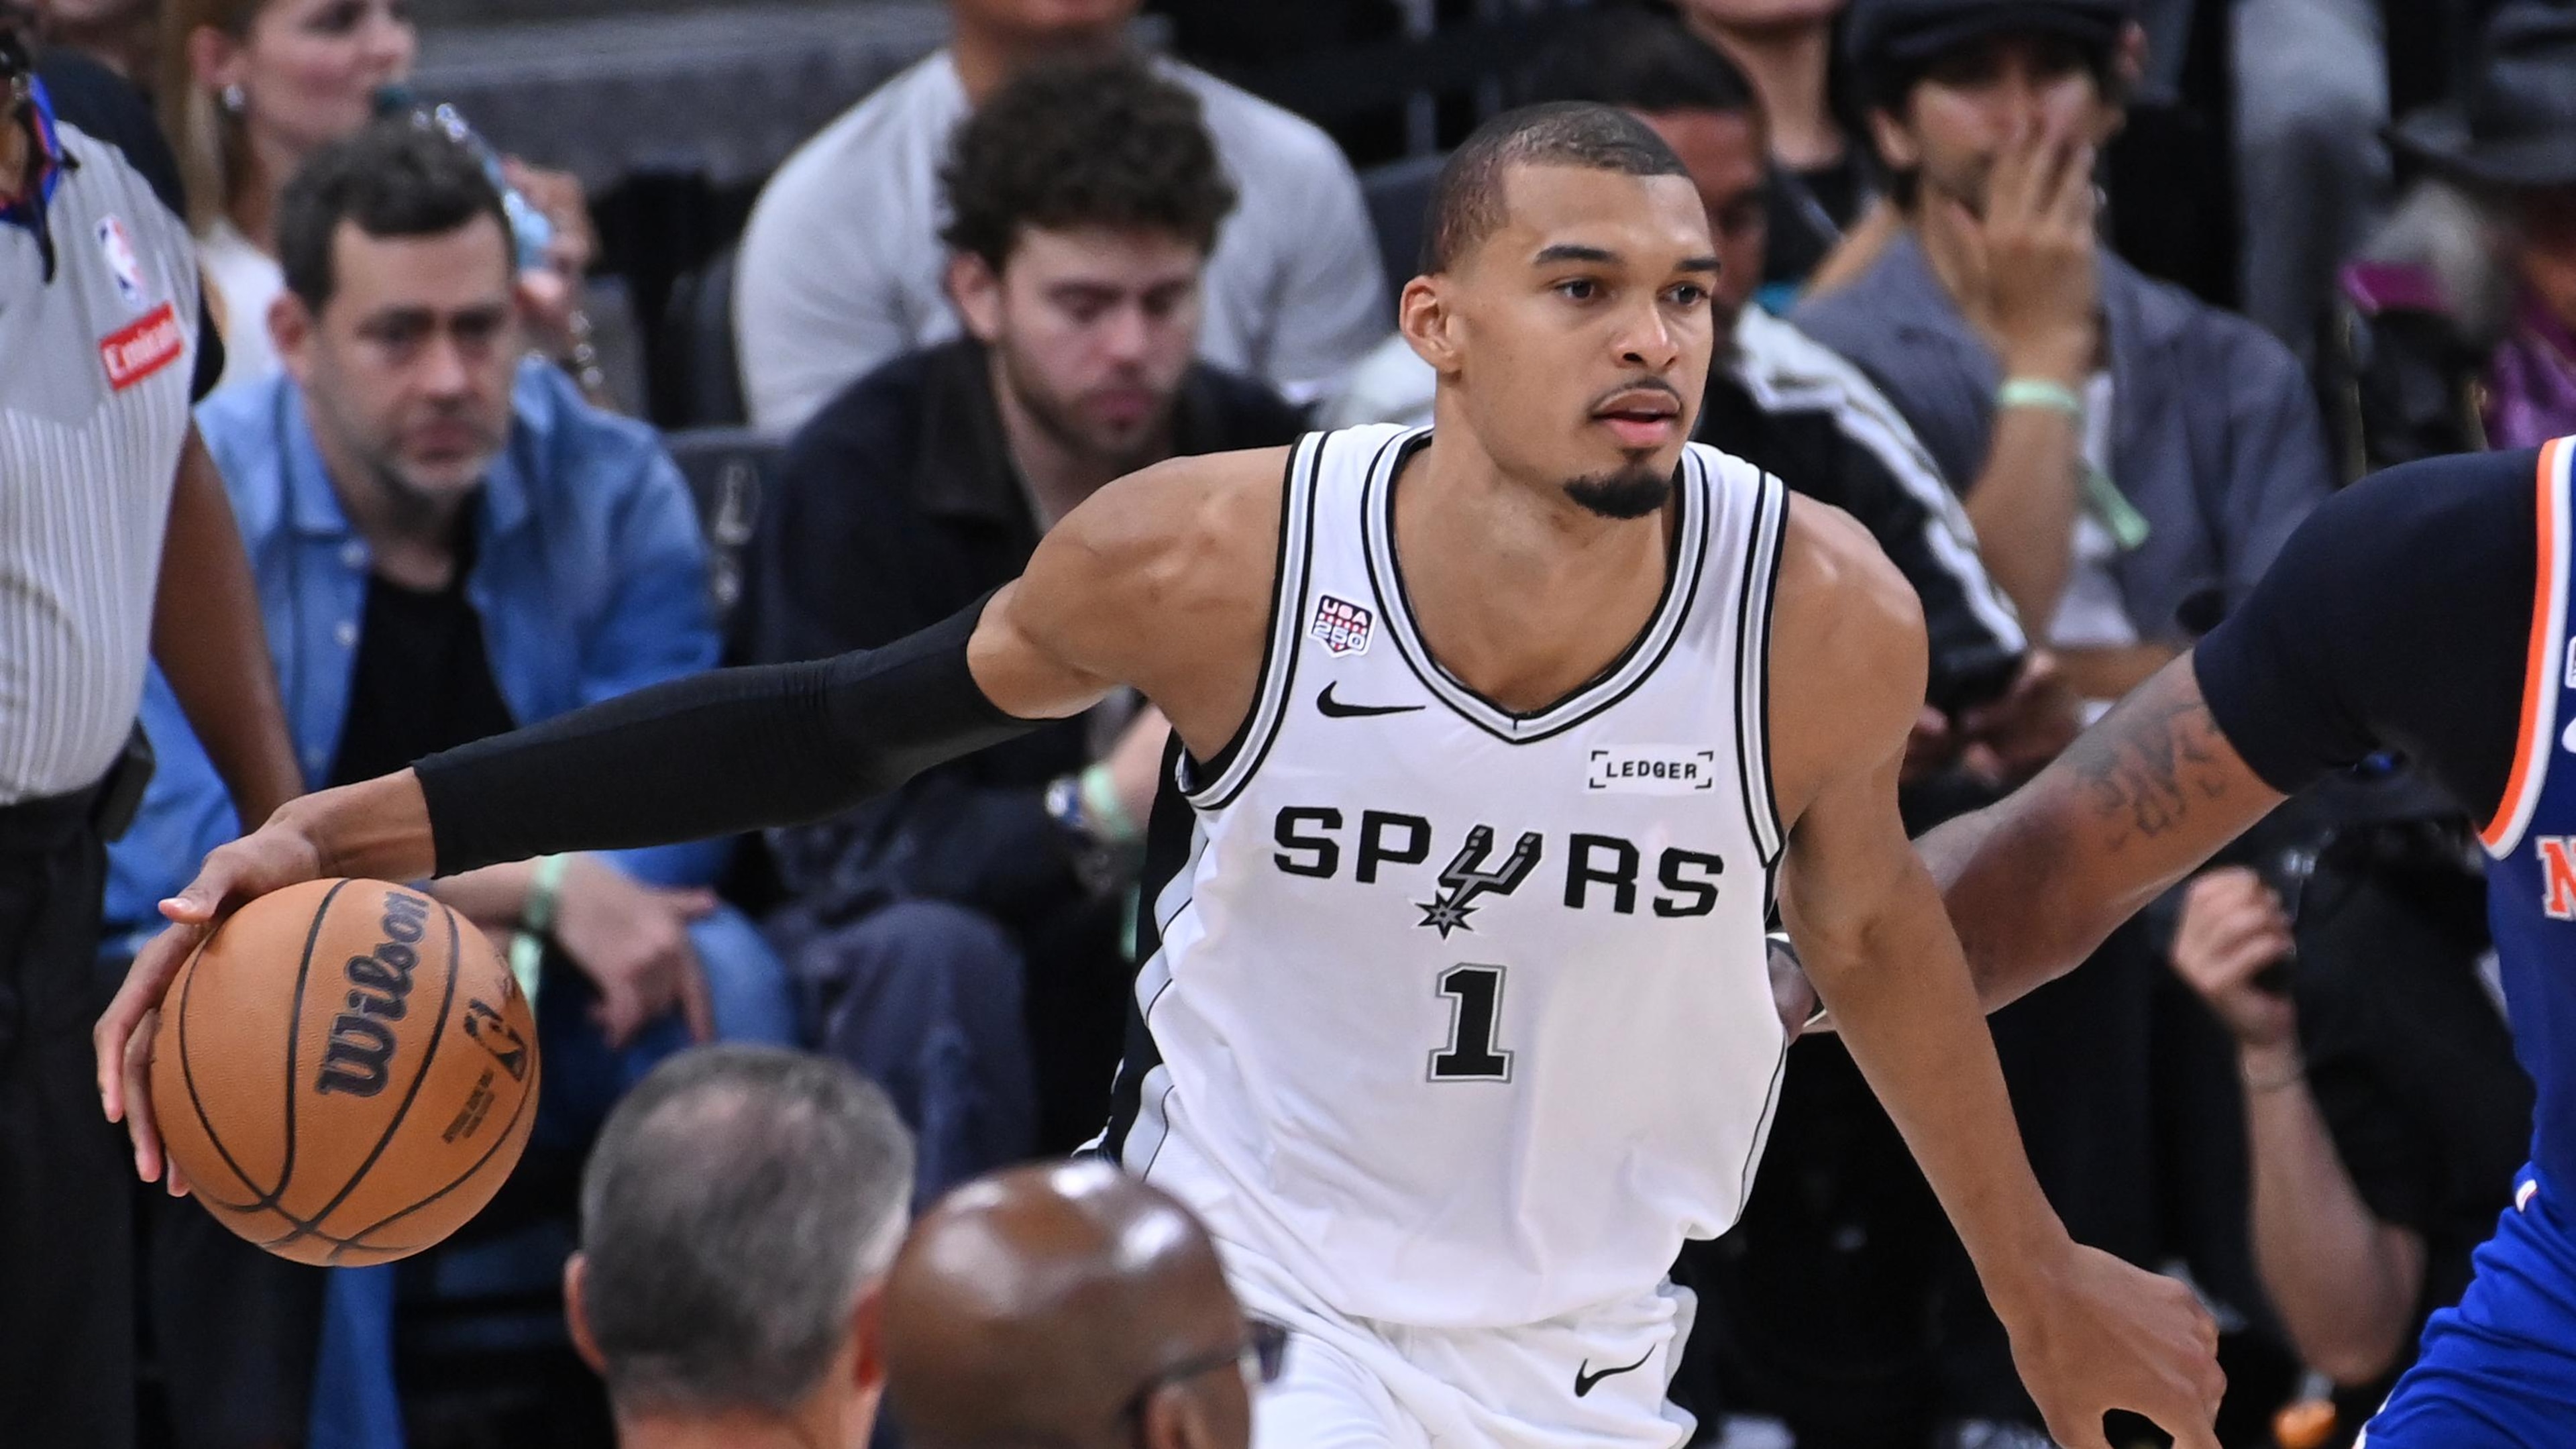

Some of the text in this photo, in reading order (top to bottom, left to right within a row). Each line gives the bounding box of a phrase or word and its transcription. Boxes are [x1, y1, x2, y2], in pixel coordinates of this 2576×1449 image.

[1322, 598, 1368, 627] USA
[1606, 761, 1697, 780] LEDGER
[315, 891, 430, 1097] Wilson
[1426, 962, 1515, 1084] 1
